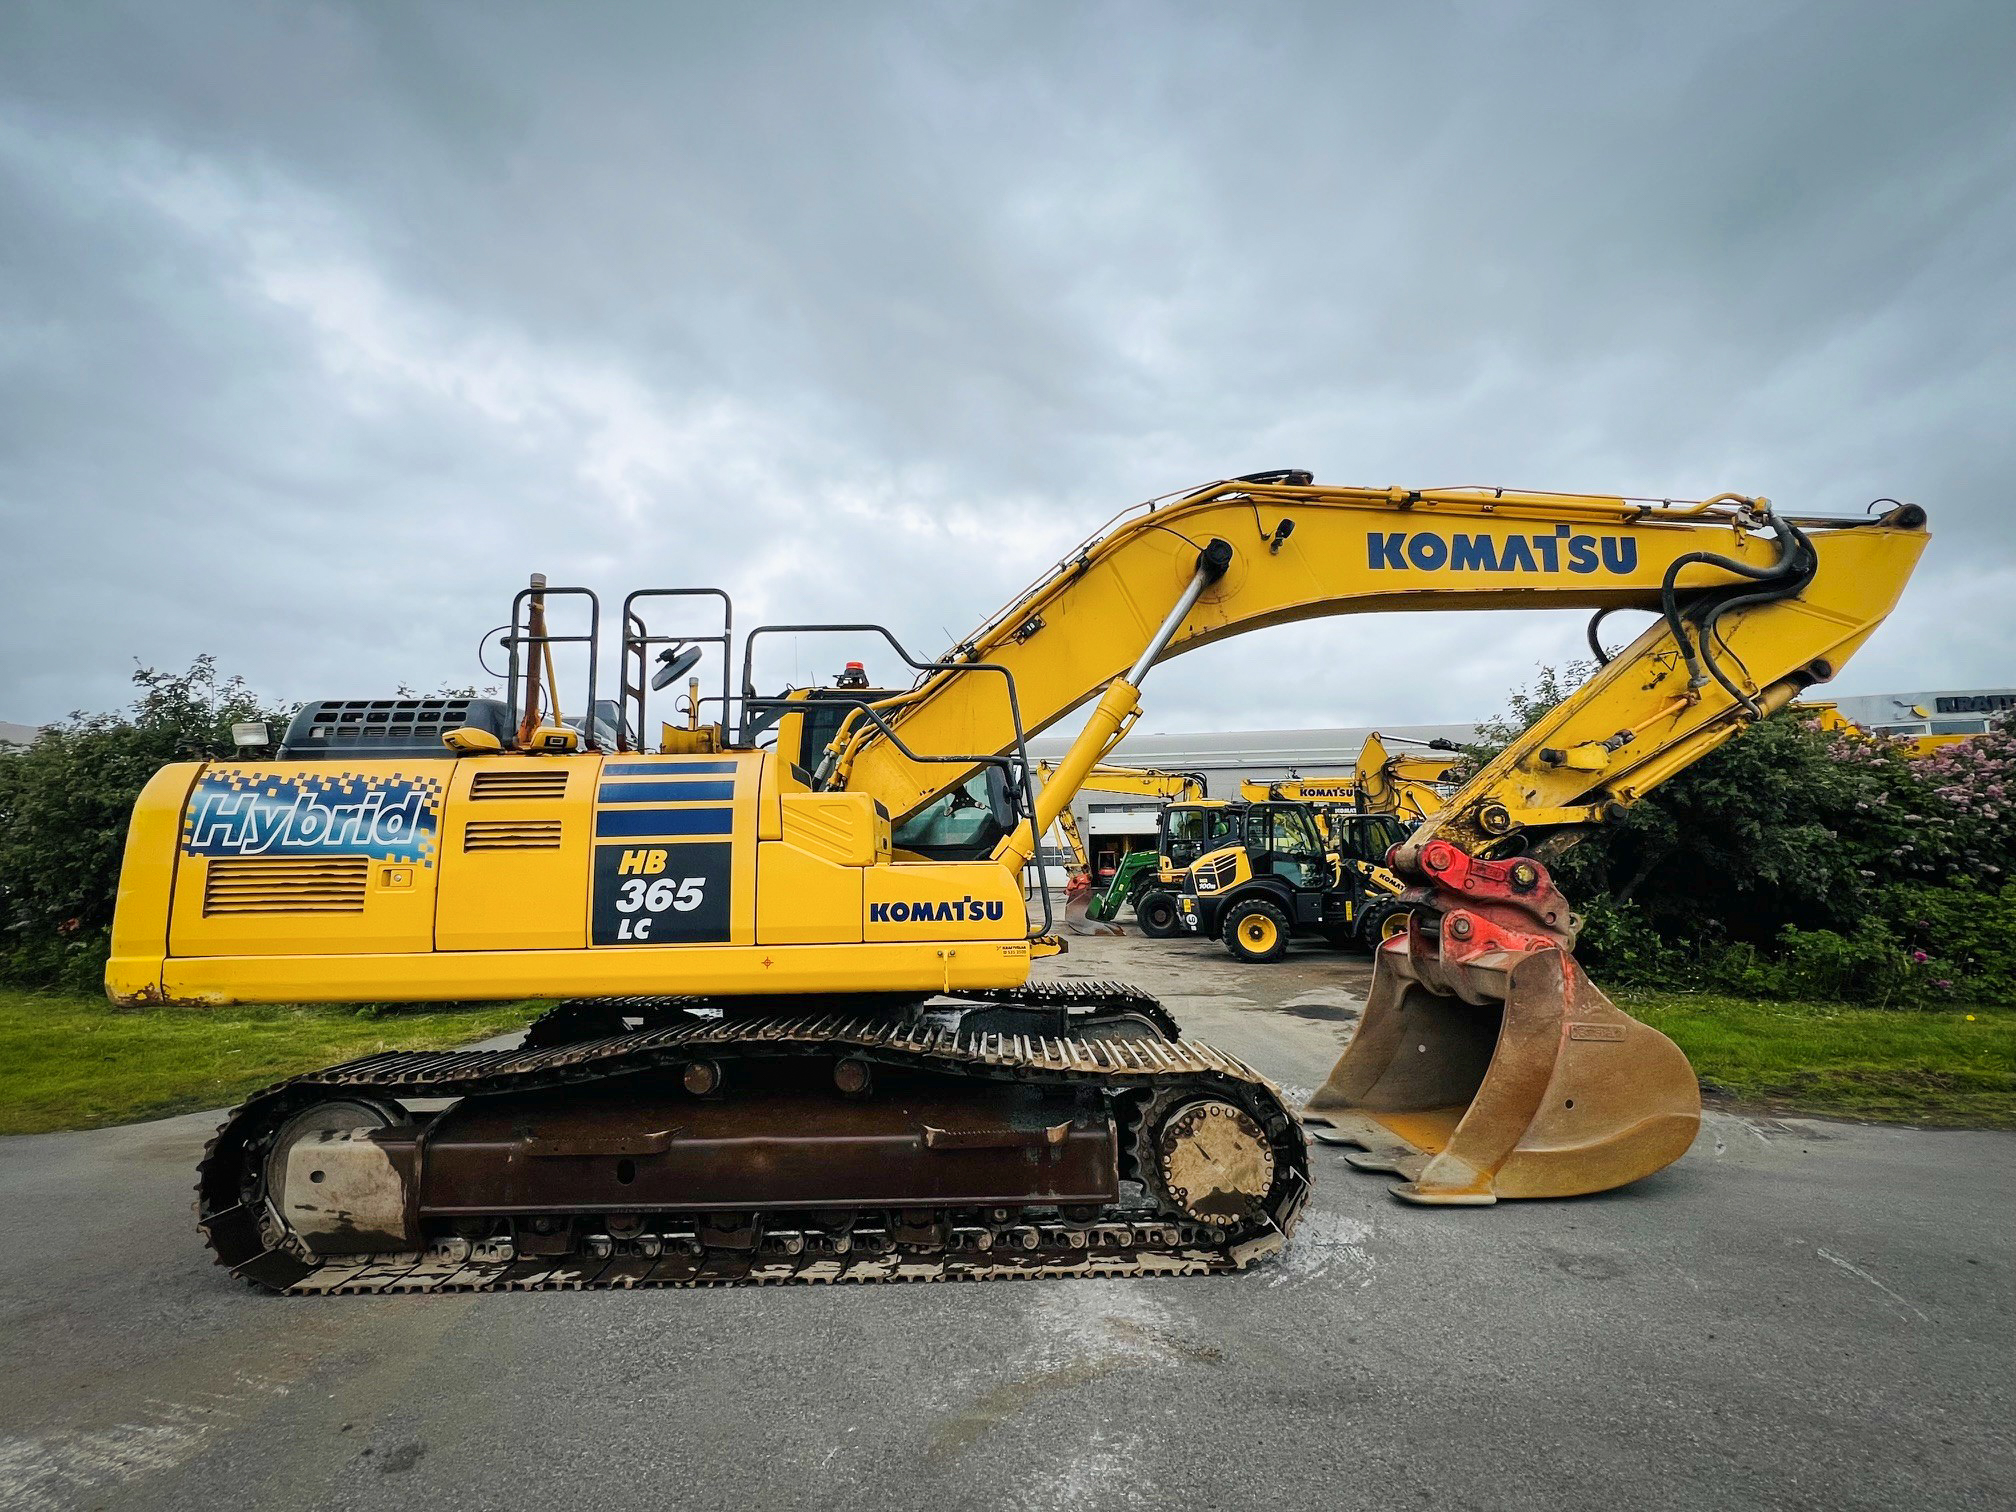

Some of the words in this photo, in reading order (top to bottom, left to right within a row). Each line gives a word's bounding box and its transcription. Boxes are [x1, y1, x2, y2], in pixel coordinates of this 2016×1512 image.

[1367, 524, 1638, 575] KOMATSU
[1300, 787, 1353, 797] KOMATSU
[192, 792, 426, 854] Hybrid
[618, 849, 668, 875] HB
[615, 877, 706, 913] 365
[870, 895, 1004, 922] KOMATSU
[617, 918, 653, 940] LC
